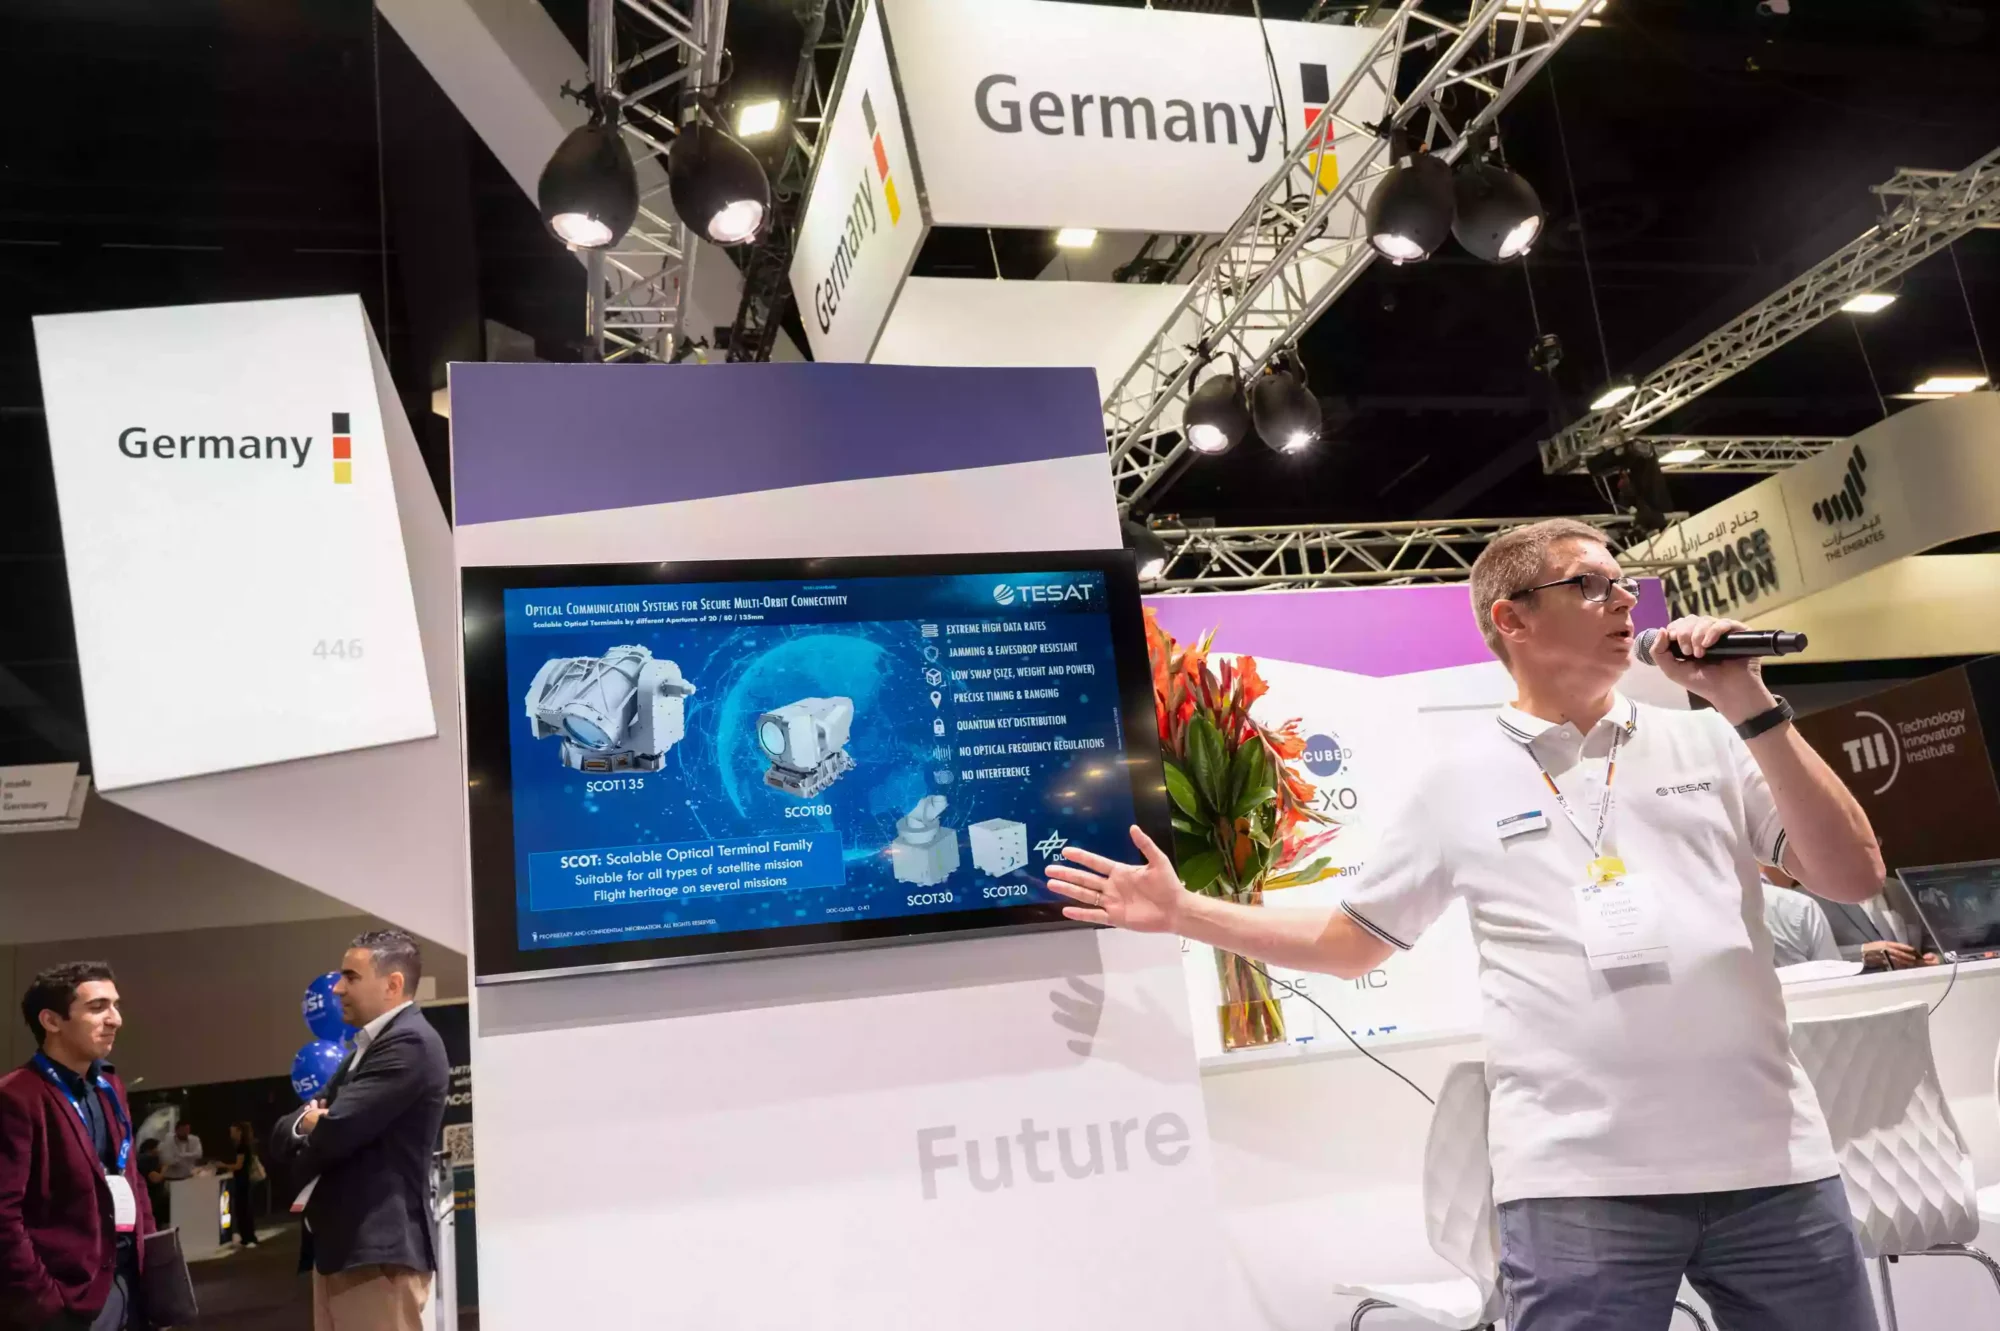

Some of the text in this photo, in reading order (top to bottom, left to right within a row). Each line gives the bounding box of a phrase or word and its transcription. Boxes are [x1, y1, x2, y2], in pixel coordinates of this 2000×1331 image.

[973, 73, 1275, 163] Germany
[815, 168, 877, 335] Germany
[118, 427, 313, 468] Germany
[1825, 530, 1885, 562] THE EMIRATES
[1664, 528, 1770, 598] AE SPACE
[1016, 584, 1093, 602] TESAT
[1671, 560, 1776, 621] AVILION
[525, 595, 848, 616] OPTICAL COMMUNICATION SYSTEMS FOR SECURE MULTI-ORBIT CONNECTIVITY
[564, 620, 588, 628] Optical
[624, 618, 634, 626] by
[946, 621, 1046, 635] EXTREME HIGH DATA RATES
[312, 638, 364, 660] 446
[950, 642, 1078, 657] JAMMING & EAVESDROP RESISTANT
[952, 664, 1095, 681] LOW SWAP (SIZE, WEIGHT AND POWER)
[954, 688, 1059, 703] PRECISE TIMING & RANGING
[957, 715, 1067, 731] QUANTUM KEY DISTRIBUTION
[1897, 708, 1966, 735] Technology
[1902, 724, 1966, 750] Innovation
[960, 739, 1105, 757] NO OPTICAL FREQUENCY REGULATIONS
[1291, 748, 1353, 763] CUBED
[1842, 732, 1890, 773] TII
[1906, 742, 1955, 764] Institute
[962, 766, 1030, 780] NO INTERFERENCE
[586, 778, 644, 793] SCOT135
[1668, 782, 1711, 794] TESAT
[785, 805, 832, 818] SCOT80
[560, 839, 813, 869] SCOT: Scalable Optical Terminal Family
[575, 858, 803, 886] Suitable for all types of satellite mission
[594, 876, 787, 902] Flight heritage on several missions
[983, 884, 1028, 898] SCOT20
[907, 892, 953, 906] SCOT30
[587, 927, 623, 936] CONFIDENTIAL
[916, 1111, 1191, 1200] Future
